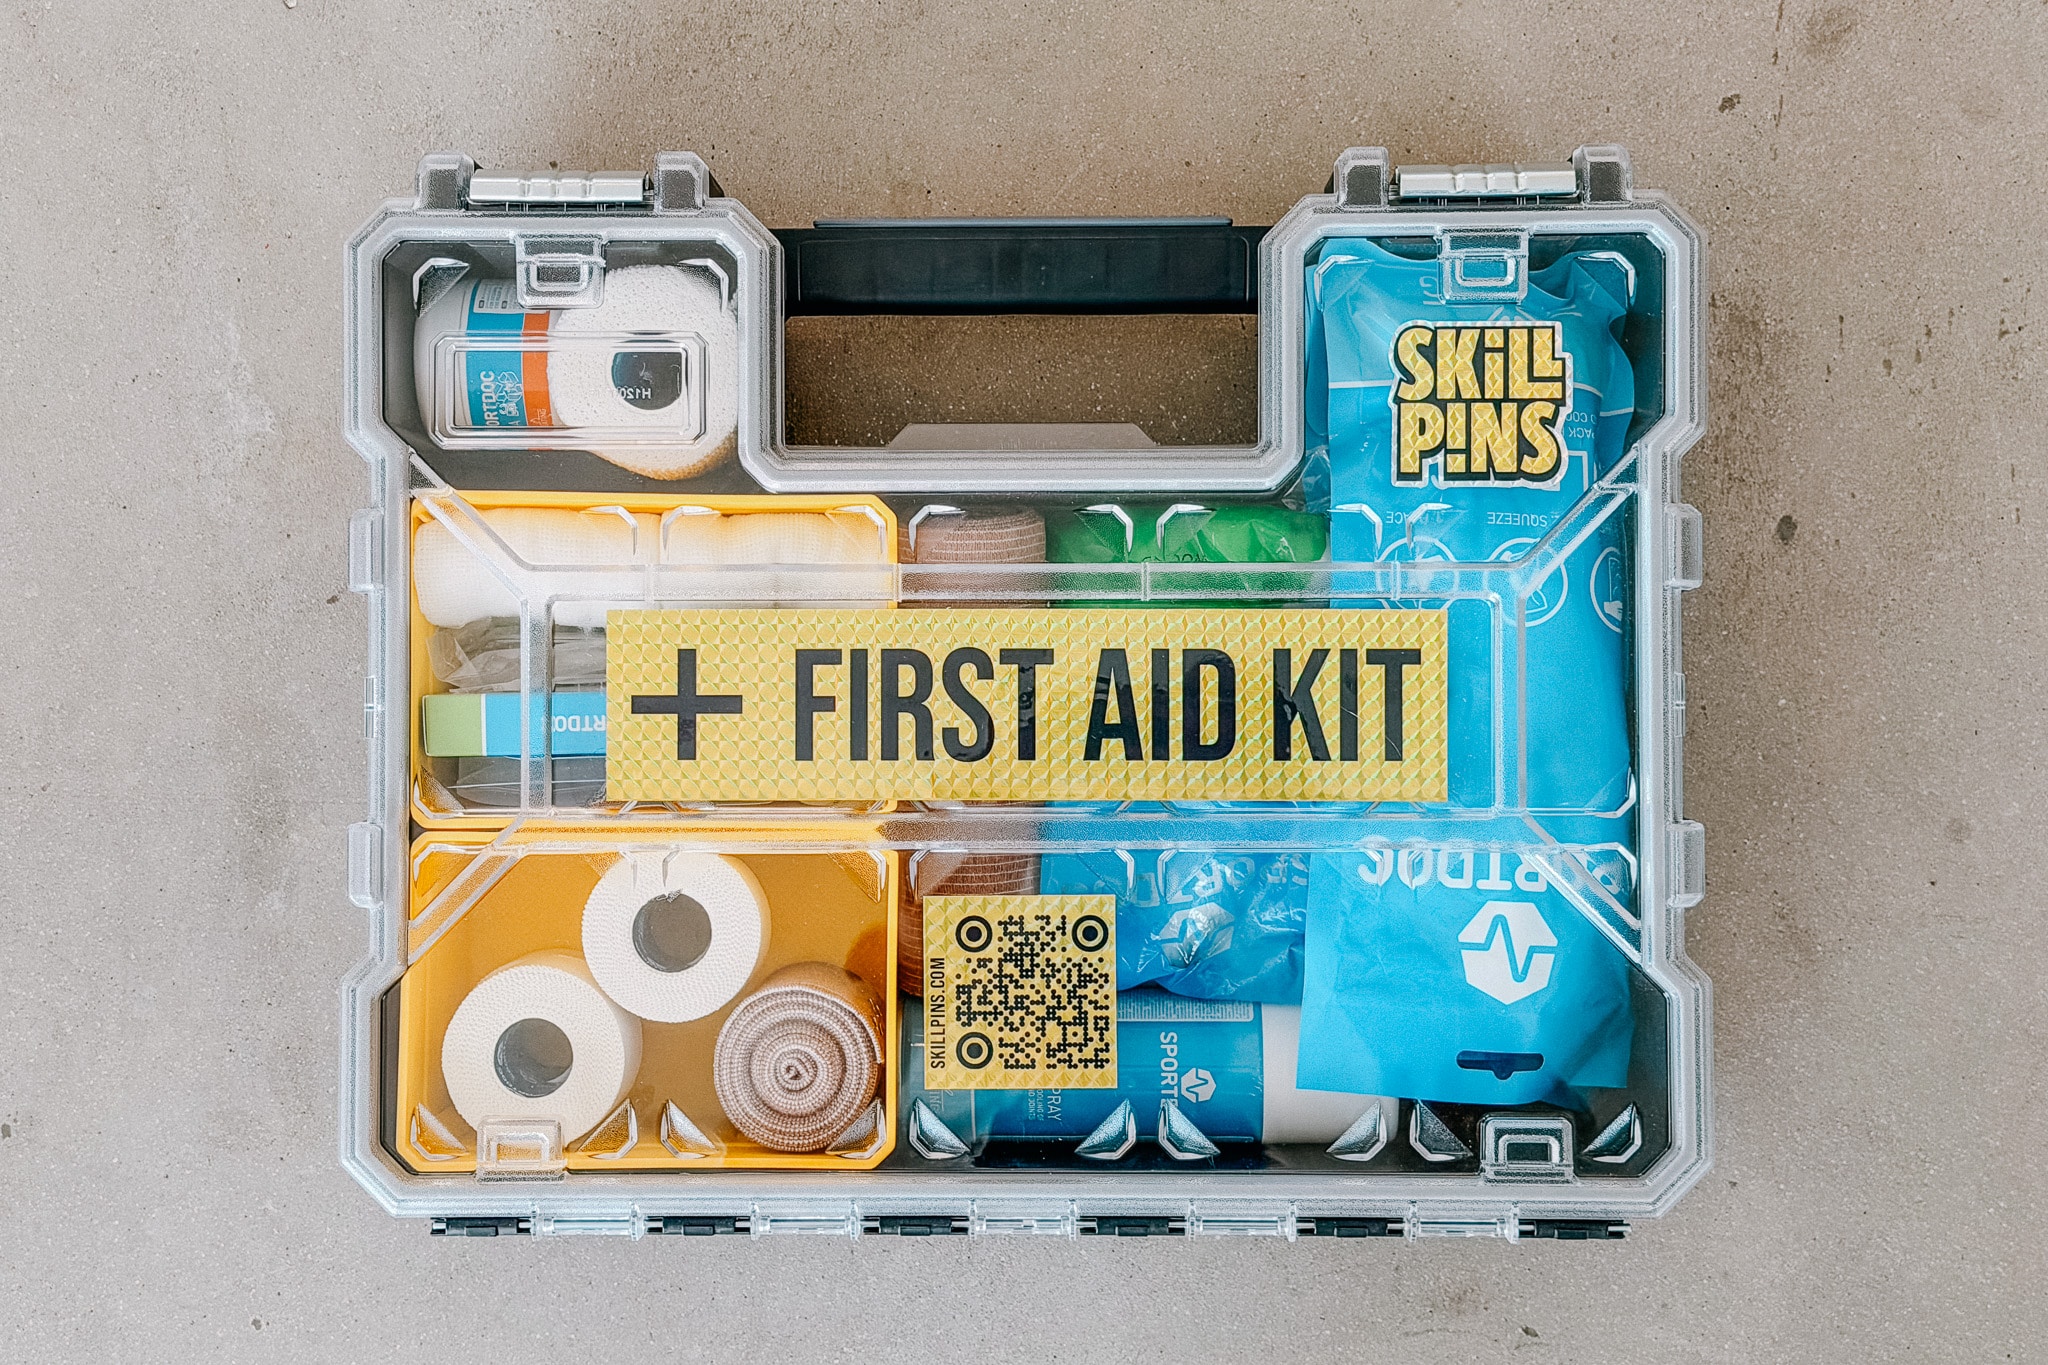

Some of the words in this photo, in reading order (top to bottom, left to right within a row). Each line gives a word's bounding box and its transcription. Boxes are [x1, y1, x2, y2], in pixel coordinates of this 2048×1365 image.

[1487, 511, 1548, 527] SQUEEZE
[794, 646, 1055, 762] FIRST
[1083, 646, 1237, 762] AID
[1272, 646, 1422, 762] KIT
[929, 957, 945, 1069] SKILLPINS.COM
